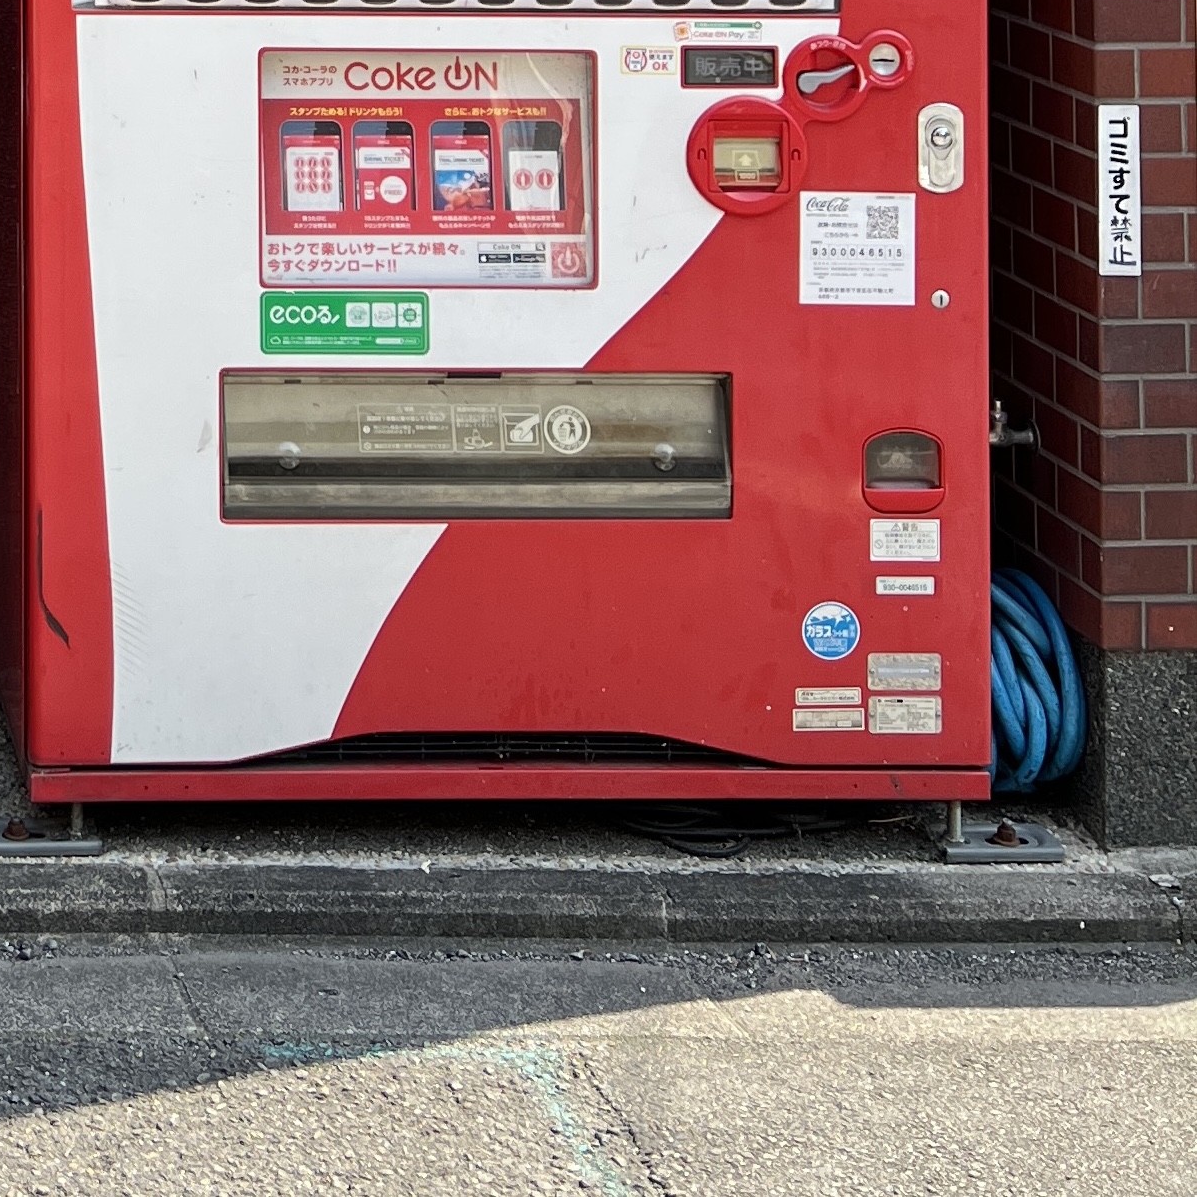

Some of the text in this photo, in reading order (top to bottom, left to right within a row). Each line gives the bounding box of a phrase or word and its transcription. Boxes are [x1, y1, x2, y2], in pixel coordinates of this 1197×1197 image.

[282, 65, 338, 74] コカ・コーラの
[652, 61, 669, 71] OK
[695, 57, 765, 77] 販売中
[344, 56, 498, 91] Coke ON
[282, 77, 334, 86] スマホアプリ
[1108, 116, 1137, 266] ゴミすて禁止
[806, 197, 851, 212] Coca-Cola
[267, 242, 466, 256] おトクで楽しいサービスが続々。
[267, 259, 397, 272] 今すぐダウンロード!!
